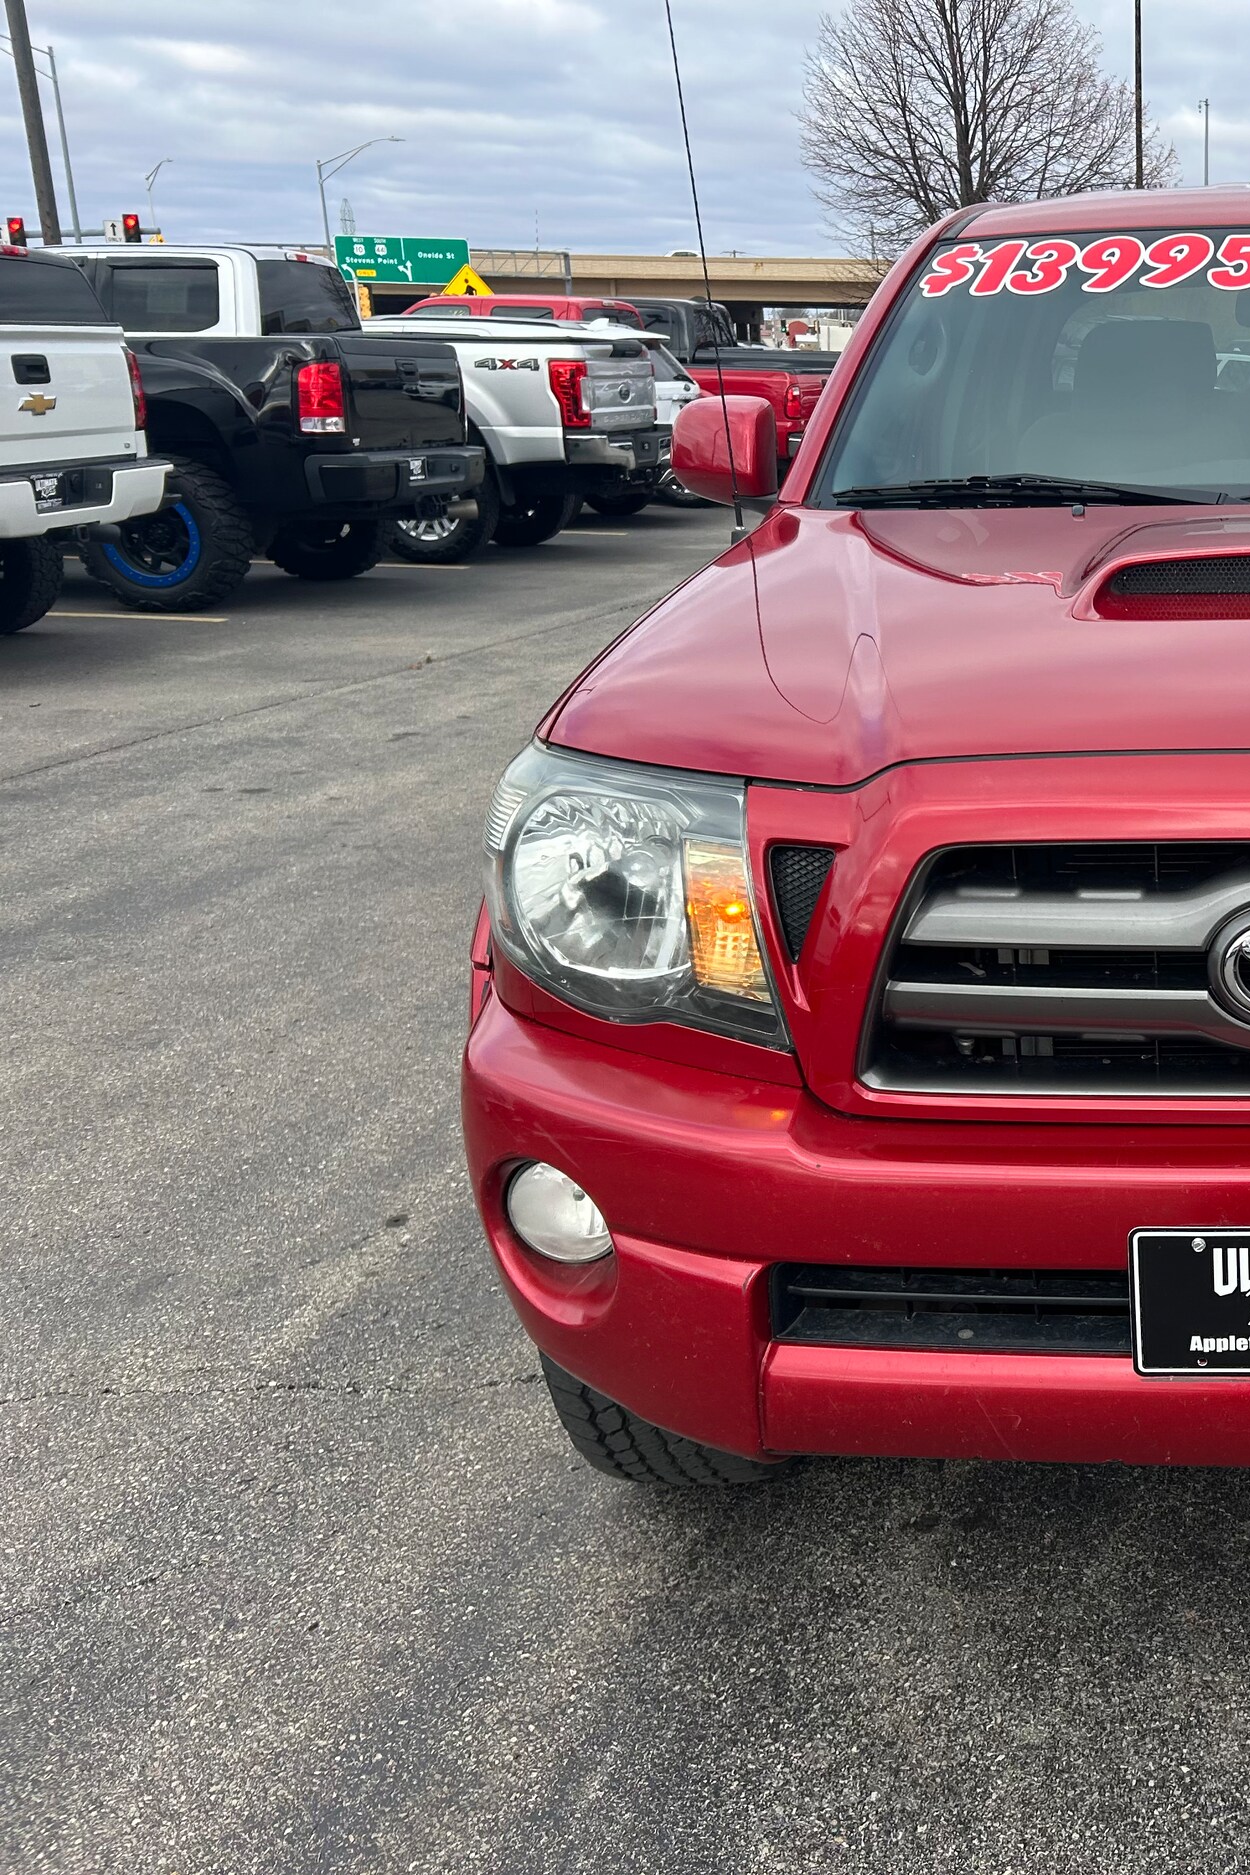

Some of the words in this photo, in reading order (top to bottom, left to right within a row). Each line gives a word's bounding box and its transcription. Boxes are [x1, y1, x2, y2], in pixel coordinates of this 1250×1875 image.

[417, 251, 443, 259] Oneida
[446, 252, 455, 260] St
[345, 256, 375, 264] Stevens
